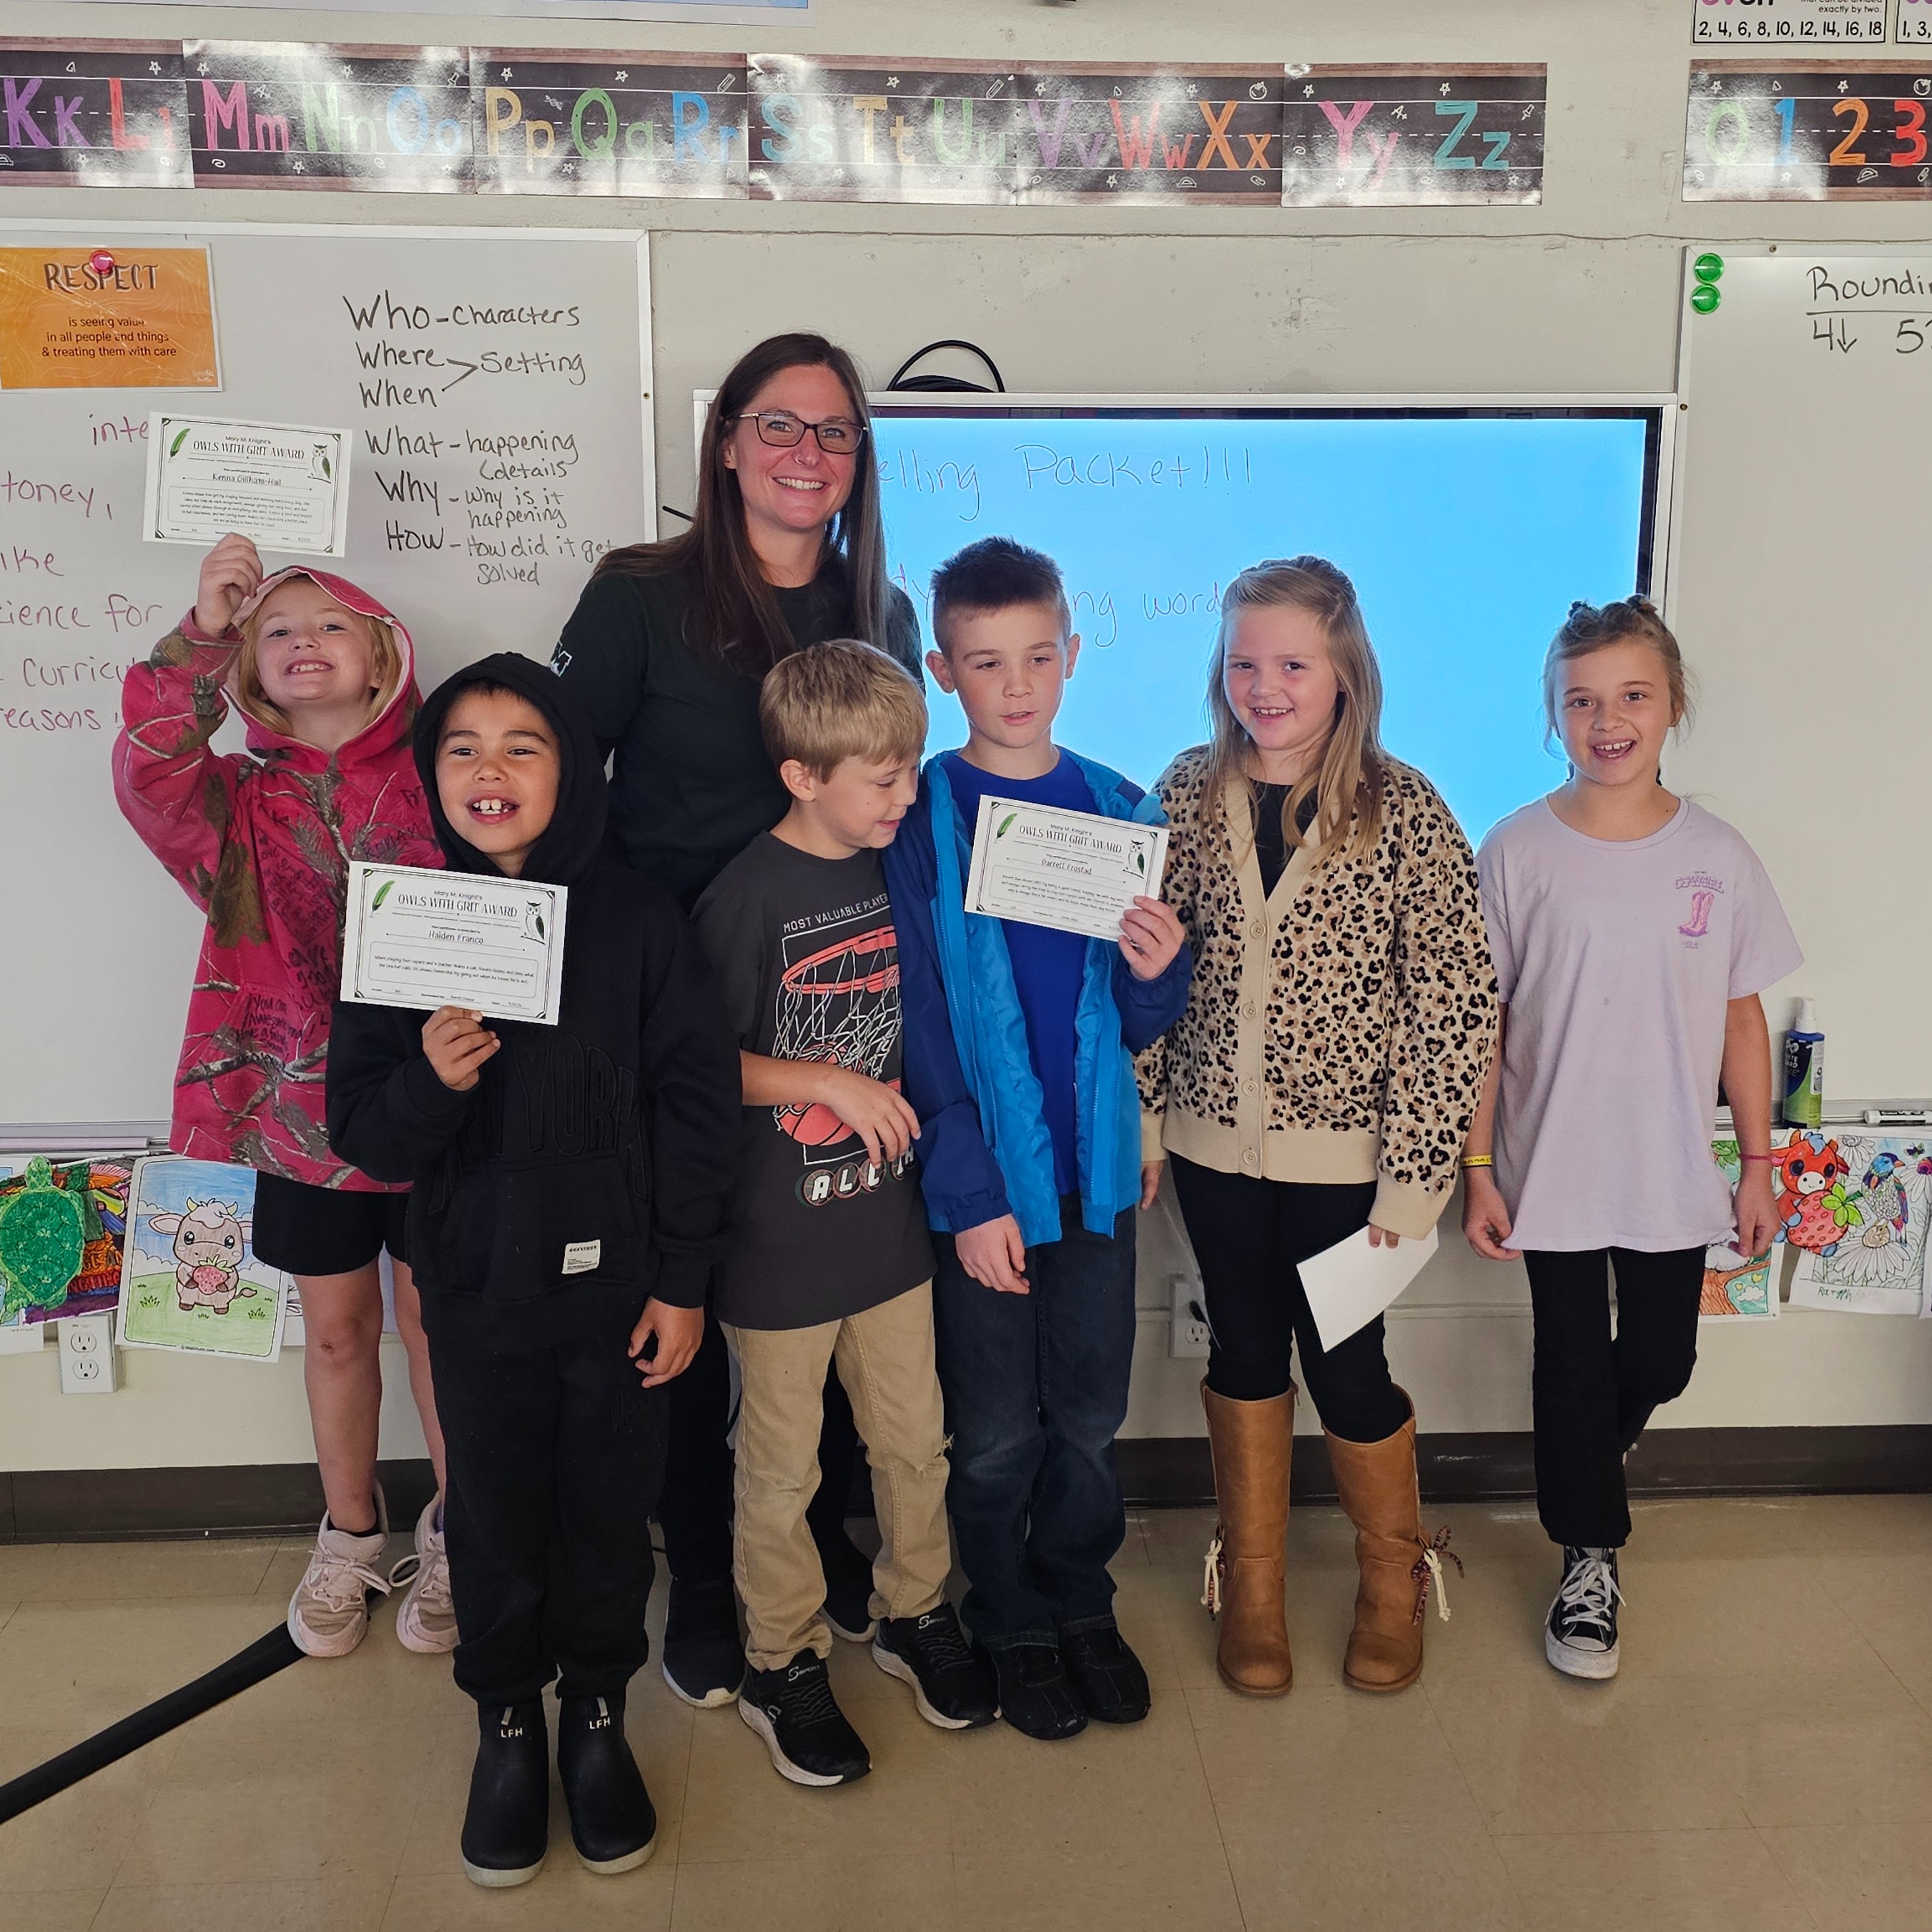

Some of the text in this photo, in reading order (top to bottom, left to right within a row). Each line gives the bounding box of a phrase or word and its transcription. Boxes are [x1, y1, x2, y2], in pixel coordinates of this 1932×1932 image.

[1699, 21, 1882, 37] 2, 4, 6, 8, 10, 12, 14, 16, 18
[1903, 21, 1931, 37] 1, 3,
[1773, 98, 1799, 167] 1
[1829, 97, 1869, 167] 2
[1890, 99, 1928, 167] 3
[1806, 265, 1932, 300] Roundi
[342, 289, 430, 331] Who
[69, 317, 78, 327] is
[80, 317, 114, 330] seeing
[1813, 317, 1923, 354] 4 5
[46, 332, 169, 344] in all people and things
[41, 346, 177, 358] & treating them with care
[355, 340, 445, 370] Where
[359, 378, 438, 408] When
[193, 440, 305, 460] OWLS WITH GRIT AWARD
[365, 425, 444, 458] What
[465, 429, 579, 465] happening
[212, 473, 236, 483] Kenna
[374, 469, 441, 517] Why
[515, 487, 536, 506] is
[542, 488, 565, 506] it
[467, 506, 568, 530] happening
[385, 518, 445, 552] How
[513, 534, 549, 558] did
[558, 535, 576, 558] it
[105, 593, 163, 633] for
[23, 656, 134, 687] Curricu
[0, 707, 102, 731] easons
[1019, 824, 1044, 838] OWLS
[1046, 829, 1068, 842] WITH
[1069, 834, 1089, 847] GRIT
[1091, 837, 1123, 854] AWARD
[1041, 858, 1065, 870] Darrell
[398, 893, 518, 918] OWLS WITH GRIT AWARD
[784, 892, 889, 934] MOST VALUABLE PLAYER
[428, 930, 484, 945] Haiden Franco
[501, 1728, 523, 1738] LFH
[589, 1717, 611, 1730] LFH
